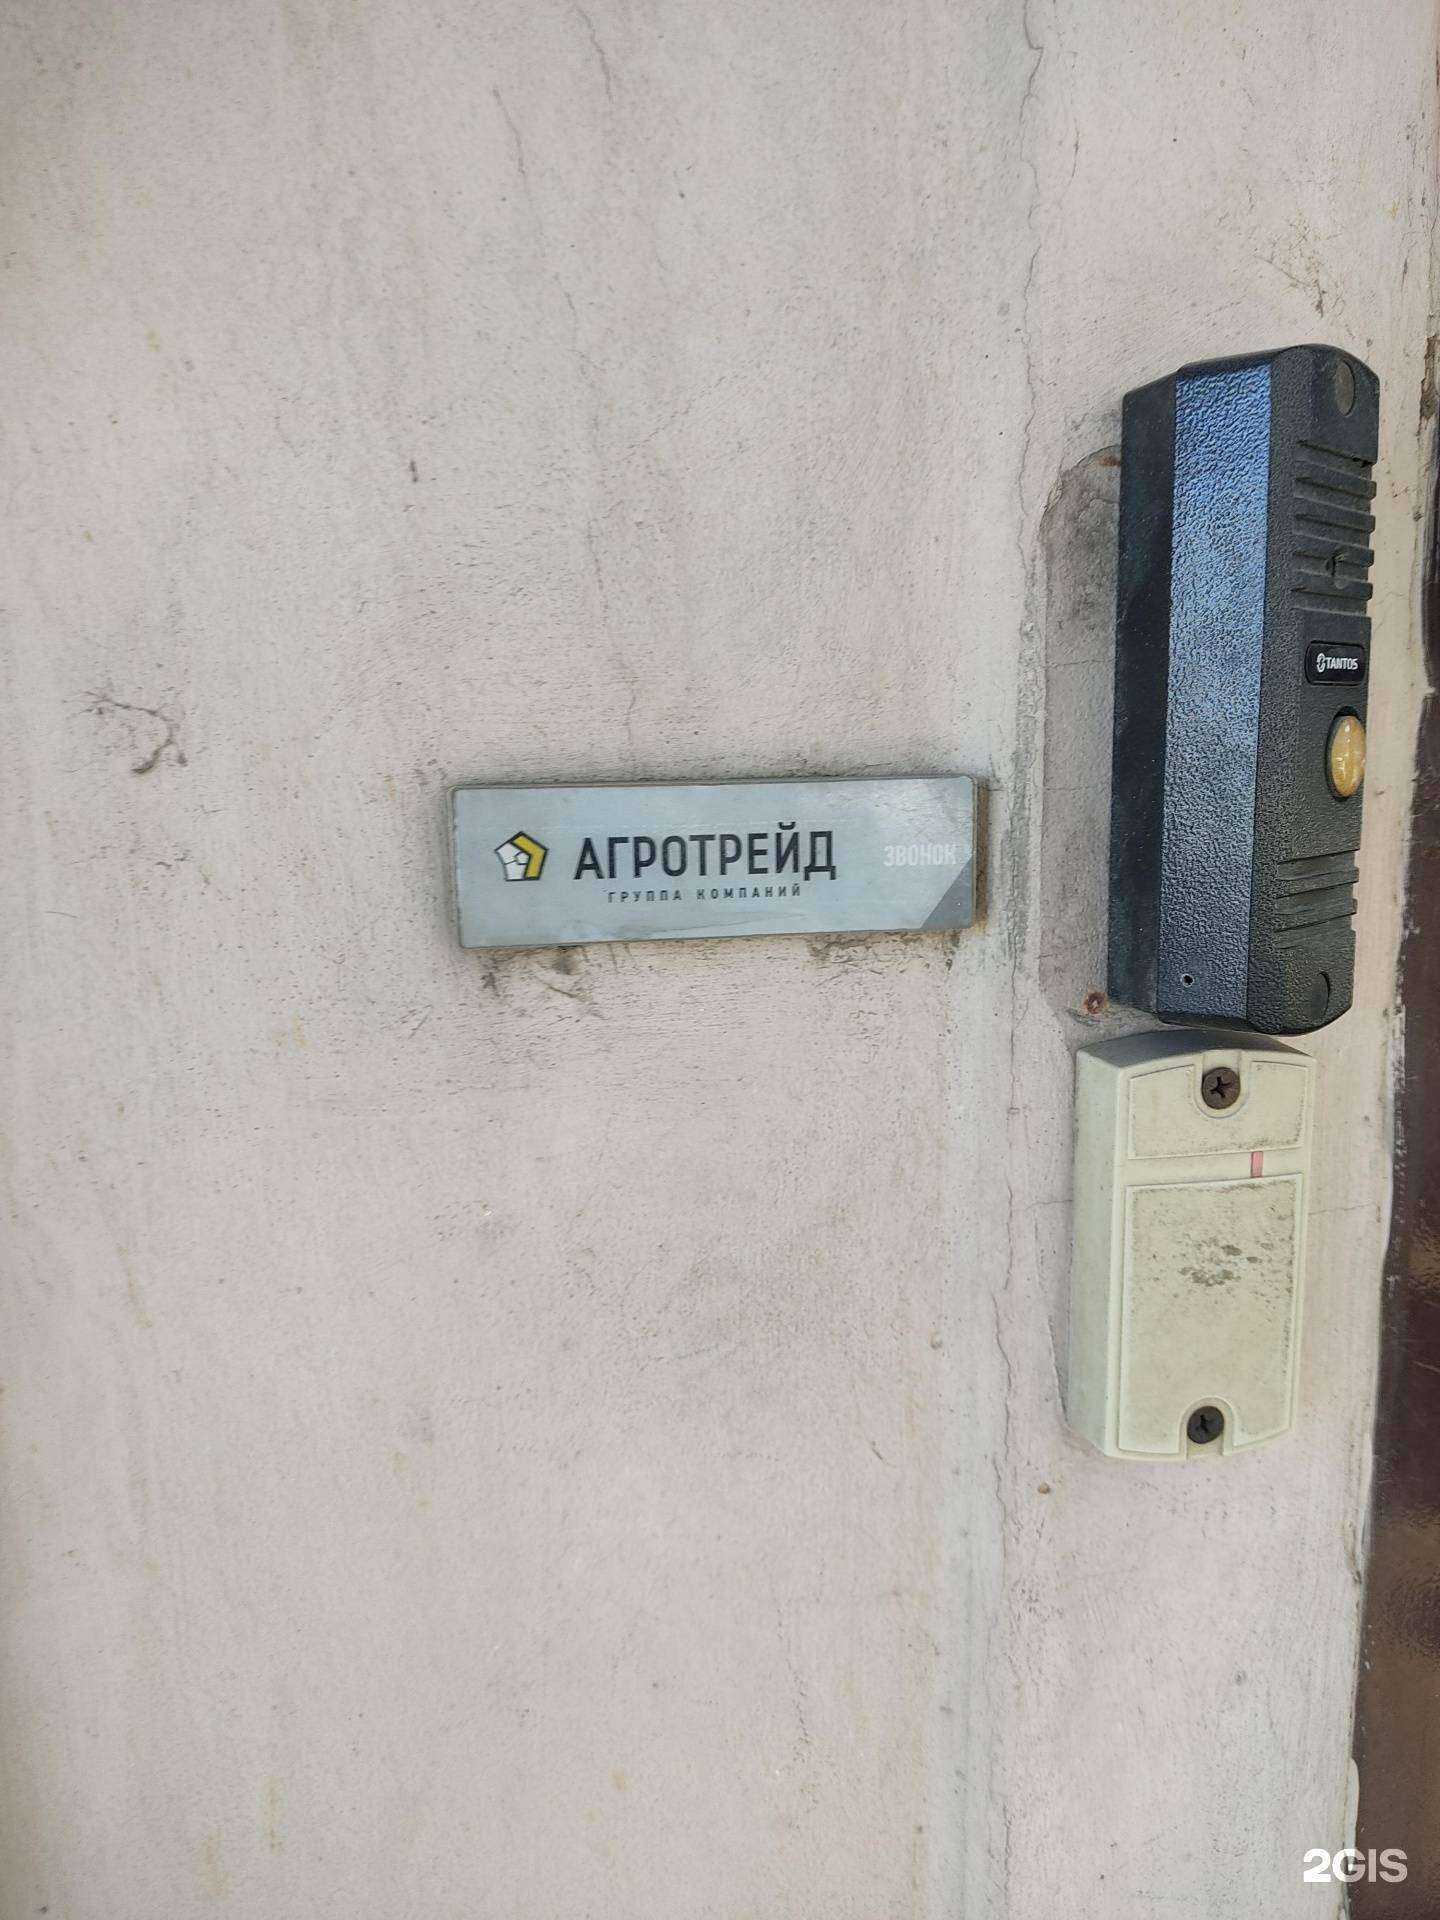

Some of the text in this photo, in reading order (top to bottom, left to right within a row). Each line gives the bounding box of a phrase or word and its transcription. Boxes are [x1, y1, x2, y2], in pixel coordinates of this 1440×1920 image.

[1326, 656, 1359, 670] TANTOS
[573, 820, 837, 881] АГРОТРЕЙД
[883, 843, 958, 867] ЗВОНОК
[607, 882, 802, 904] ГРУППА КОМПАНИЙ
